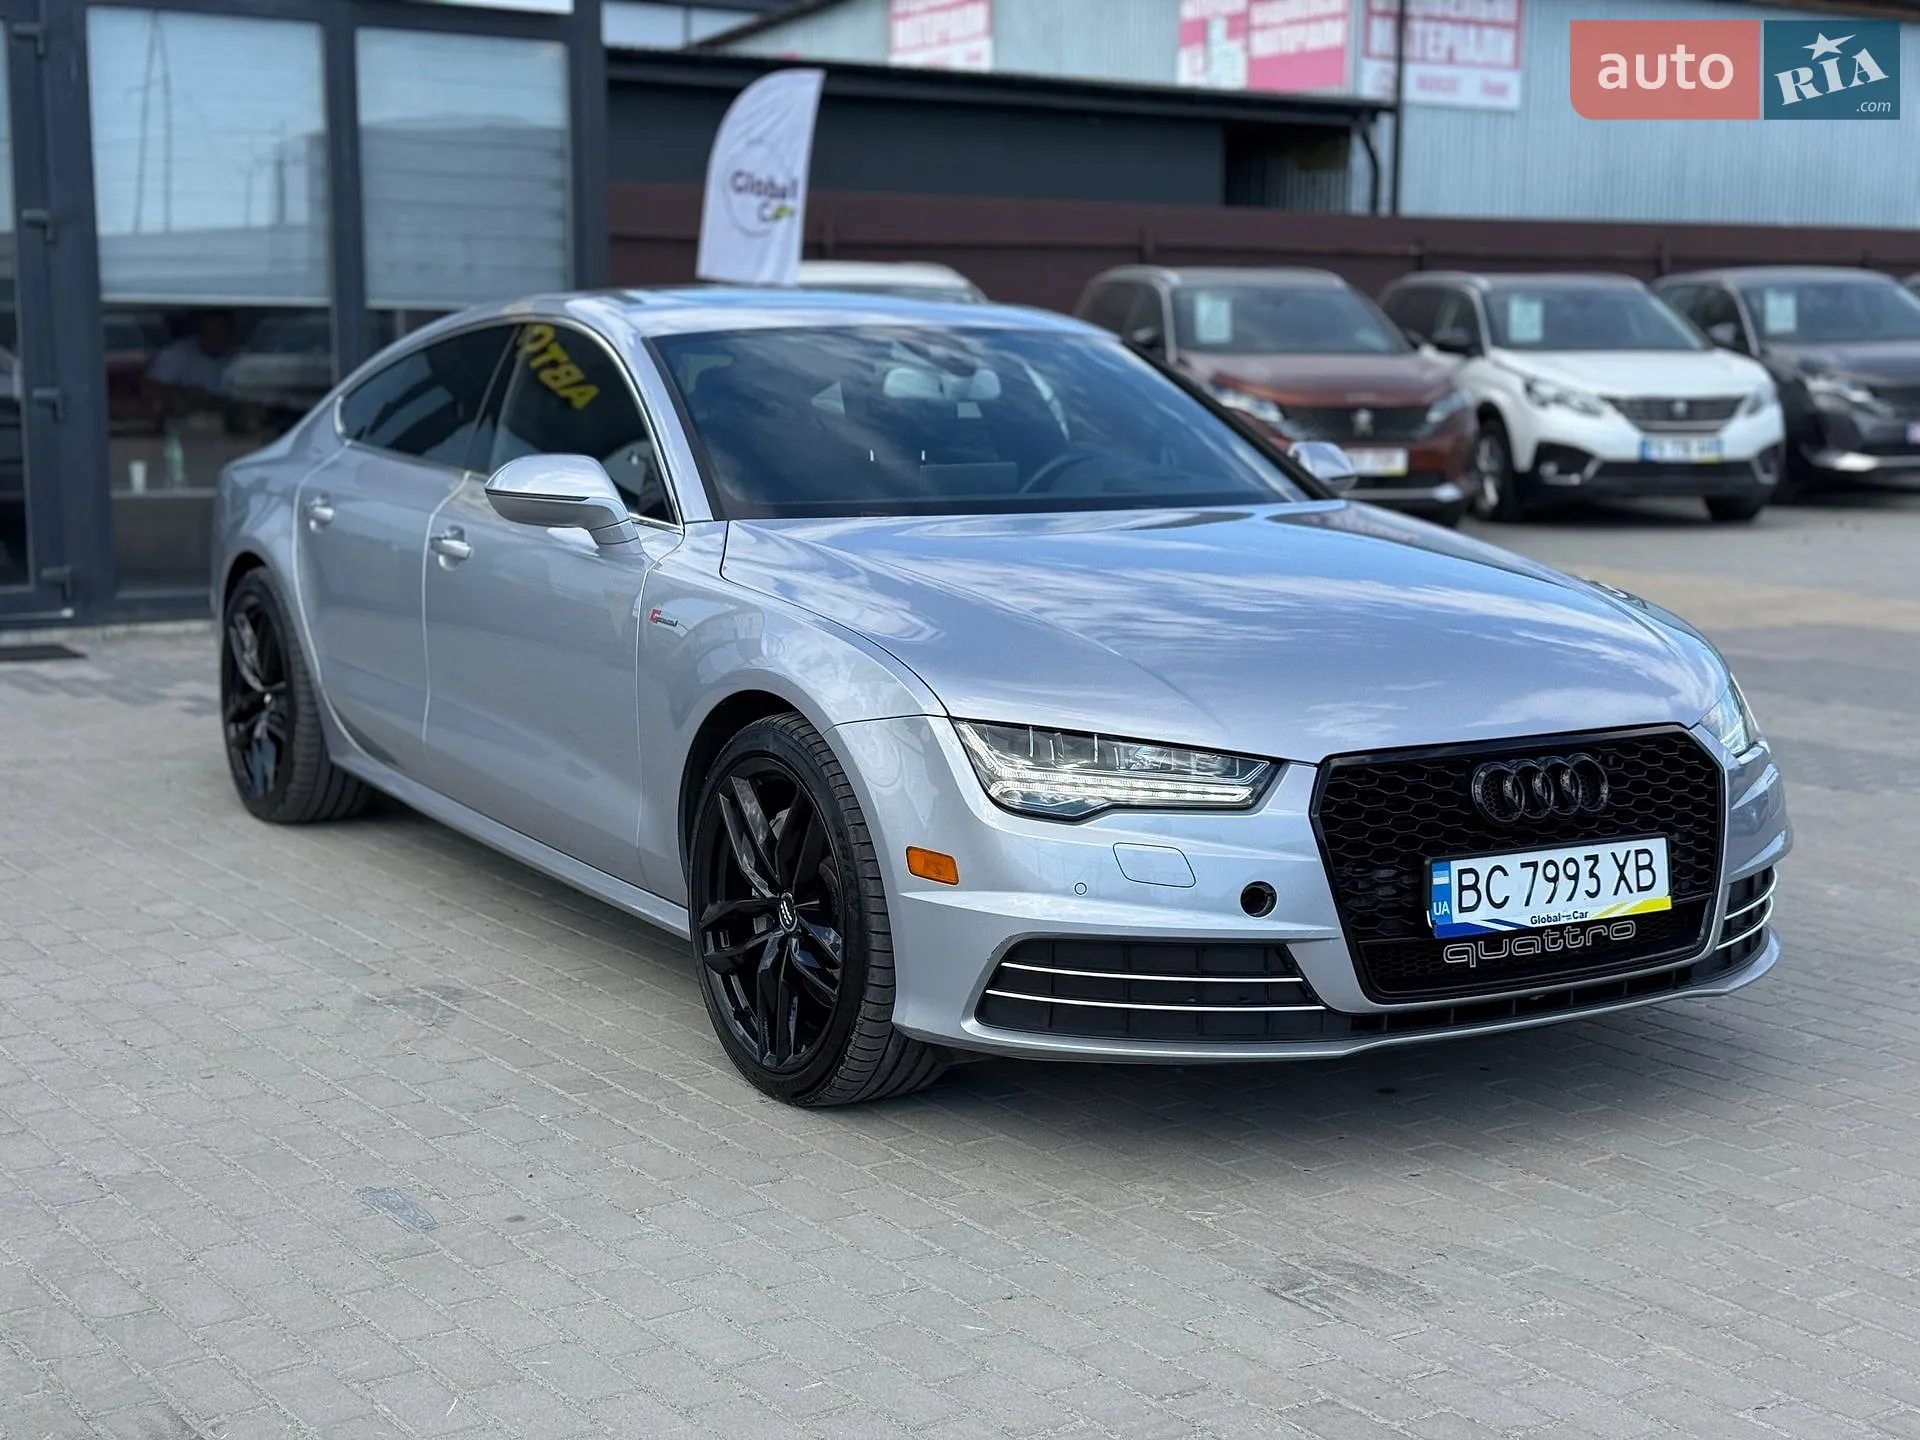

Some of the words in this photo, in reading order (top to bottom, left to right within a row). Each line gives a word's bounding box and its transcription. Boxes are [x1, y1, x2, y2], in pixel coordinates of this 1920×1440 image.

[729, 168, 799, 200] Global
[1457, 864, 1510, 914] BC
[1520, 853, 1601, 907] 7993
[1610, 848, 1657, 896] XB
[1433, 902, 1450, 916] UA
[1530, 912, 1562, 925] Global
[1572, 910, 1590, 921] Car
[1443, 920, 1636, 968] quattro
